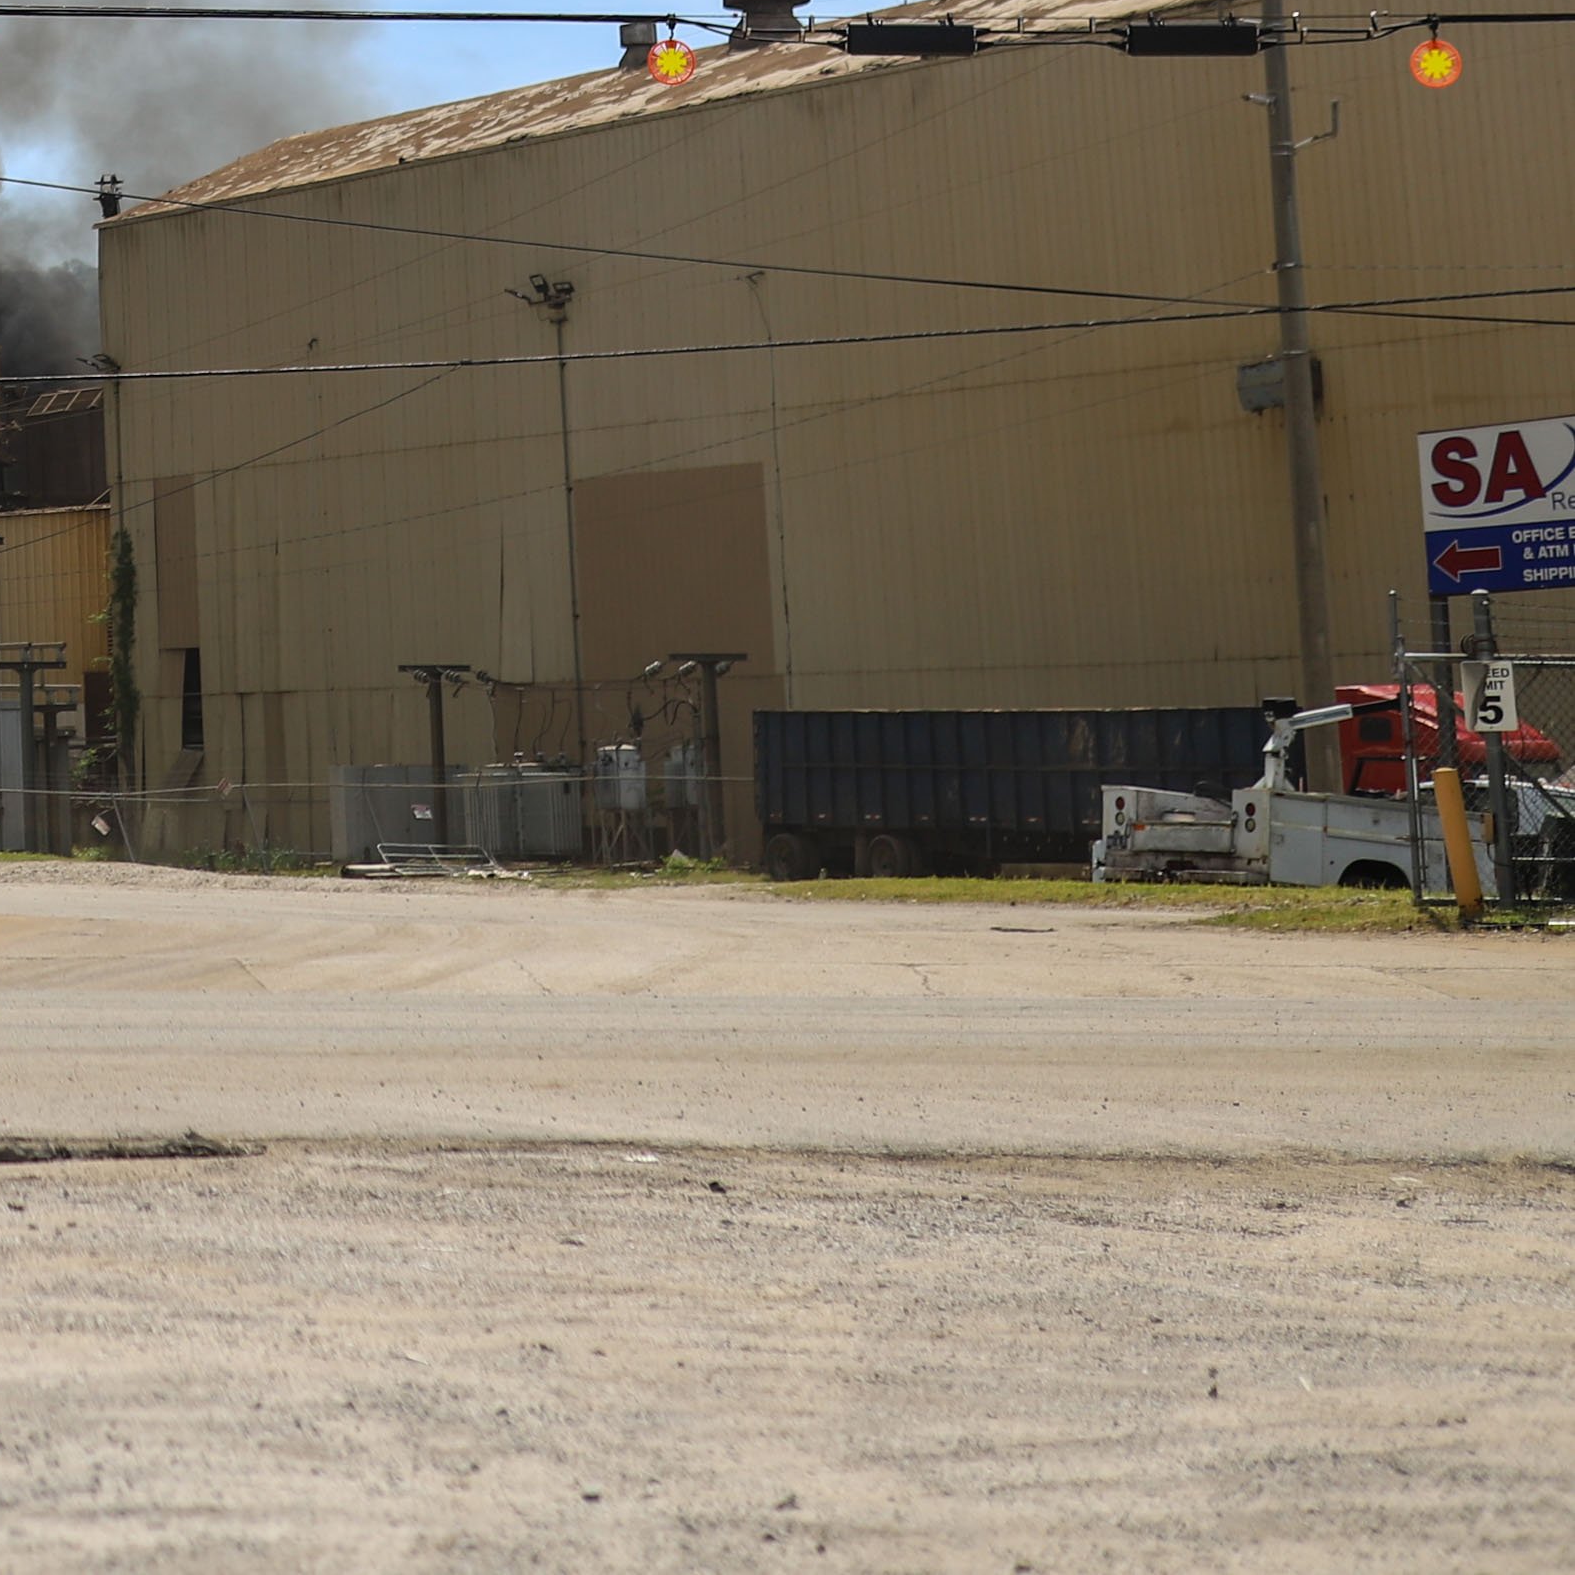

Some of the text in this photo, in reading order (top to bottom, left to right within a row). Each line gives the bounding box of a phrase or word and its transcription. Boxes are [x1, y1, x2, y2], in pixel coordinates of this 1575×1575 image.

[1431, 430, 1547, 508] SA
[1511, 527, 1565, 544] OFFICE
[1523, 547, 1534, 560] &
[1537, 544, 1569, 559] ATM
[1522, 566, 1575, 583] SHIPPI
[1482, 680, 1506, 691] MIT
